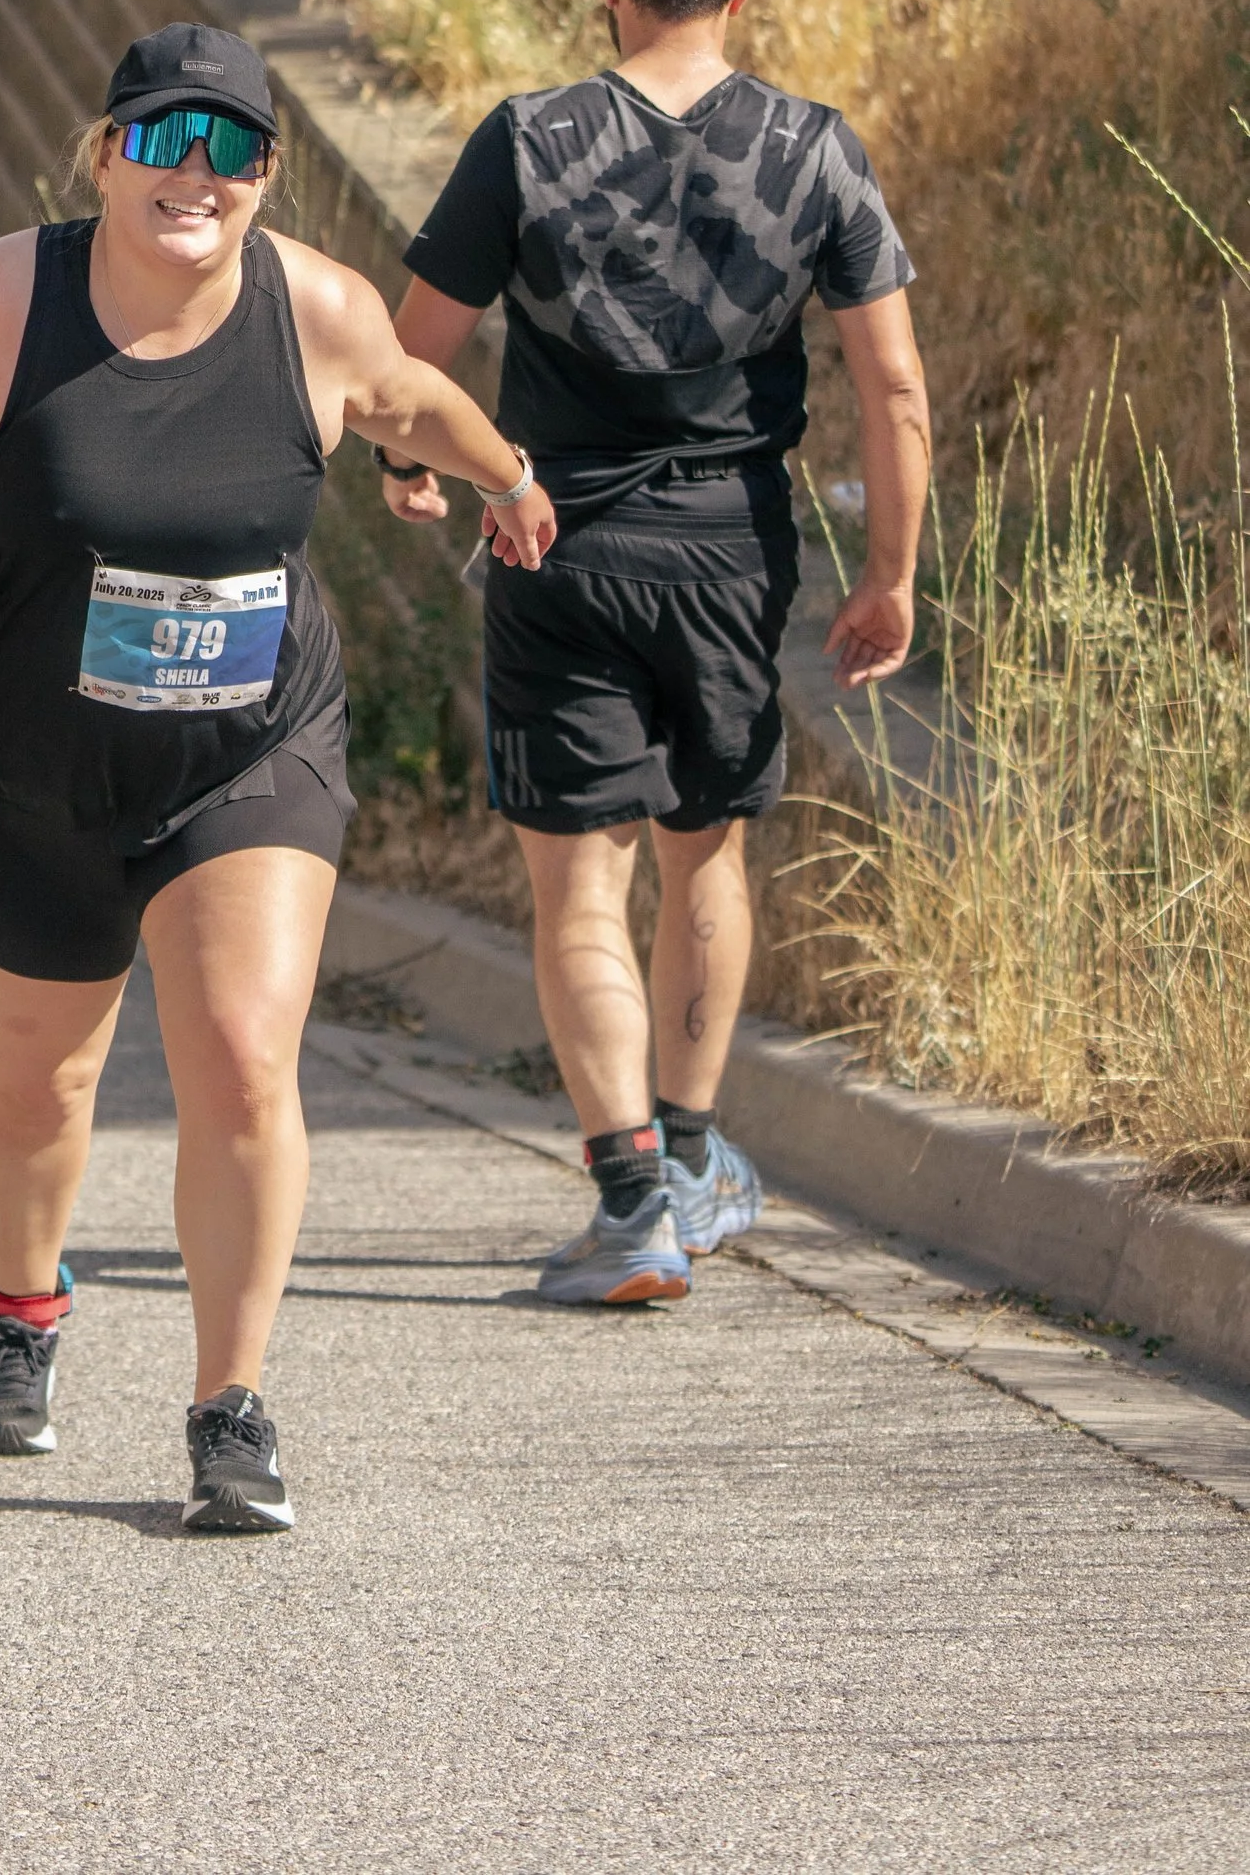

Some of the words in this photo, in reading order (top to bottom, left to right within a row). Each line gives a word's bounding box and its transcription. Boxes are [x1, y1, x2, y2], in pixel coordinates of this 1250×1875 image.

[94, 581, 116, 596] July
[137, 588, 165, 602] 2025
[242, 590, 258, 603] Try
[258, 588, 265, 600] A
[265, 586, 278, 599] Tri
[151, 618, 227, 660] 979
[155, 668, 209, 686] SHEILA
[202, 697, 220, 705] 70
